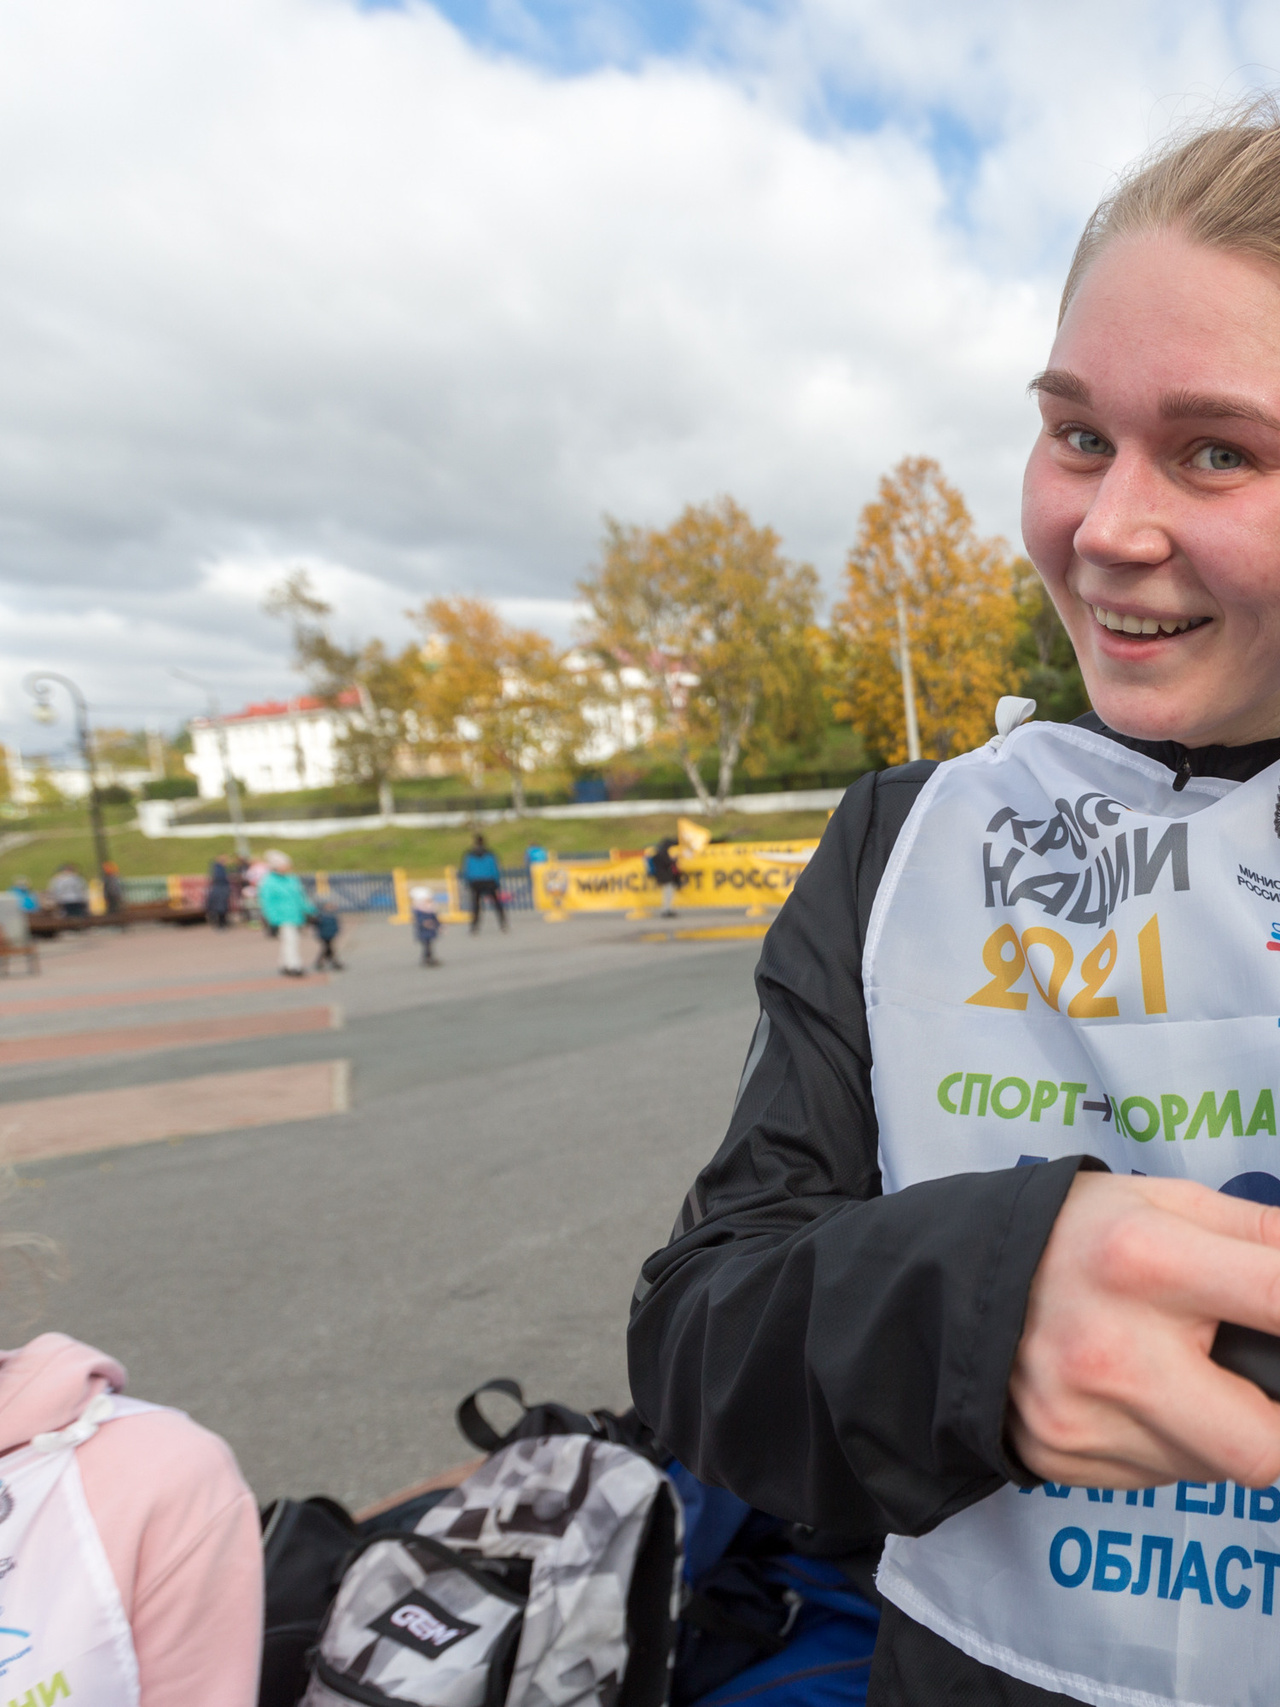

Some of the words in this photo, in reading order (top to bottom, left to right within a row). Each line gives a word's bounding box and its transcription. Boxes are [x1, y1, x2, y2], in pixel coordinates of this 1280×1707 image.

[576, 870, 703, 894] МИНСРТ
[983, 823, 1190, 929] НАЦИИ
[963, 913, 1168, 1019] 2021
[937, 1071, 1087, 1126] СПОРТ
